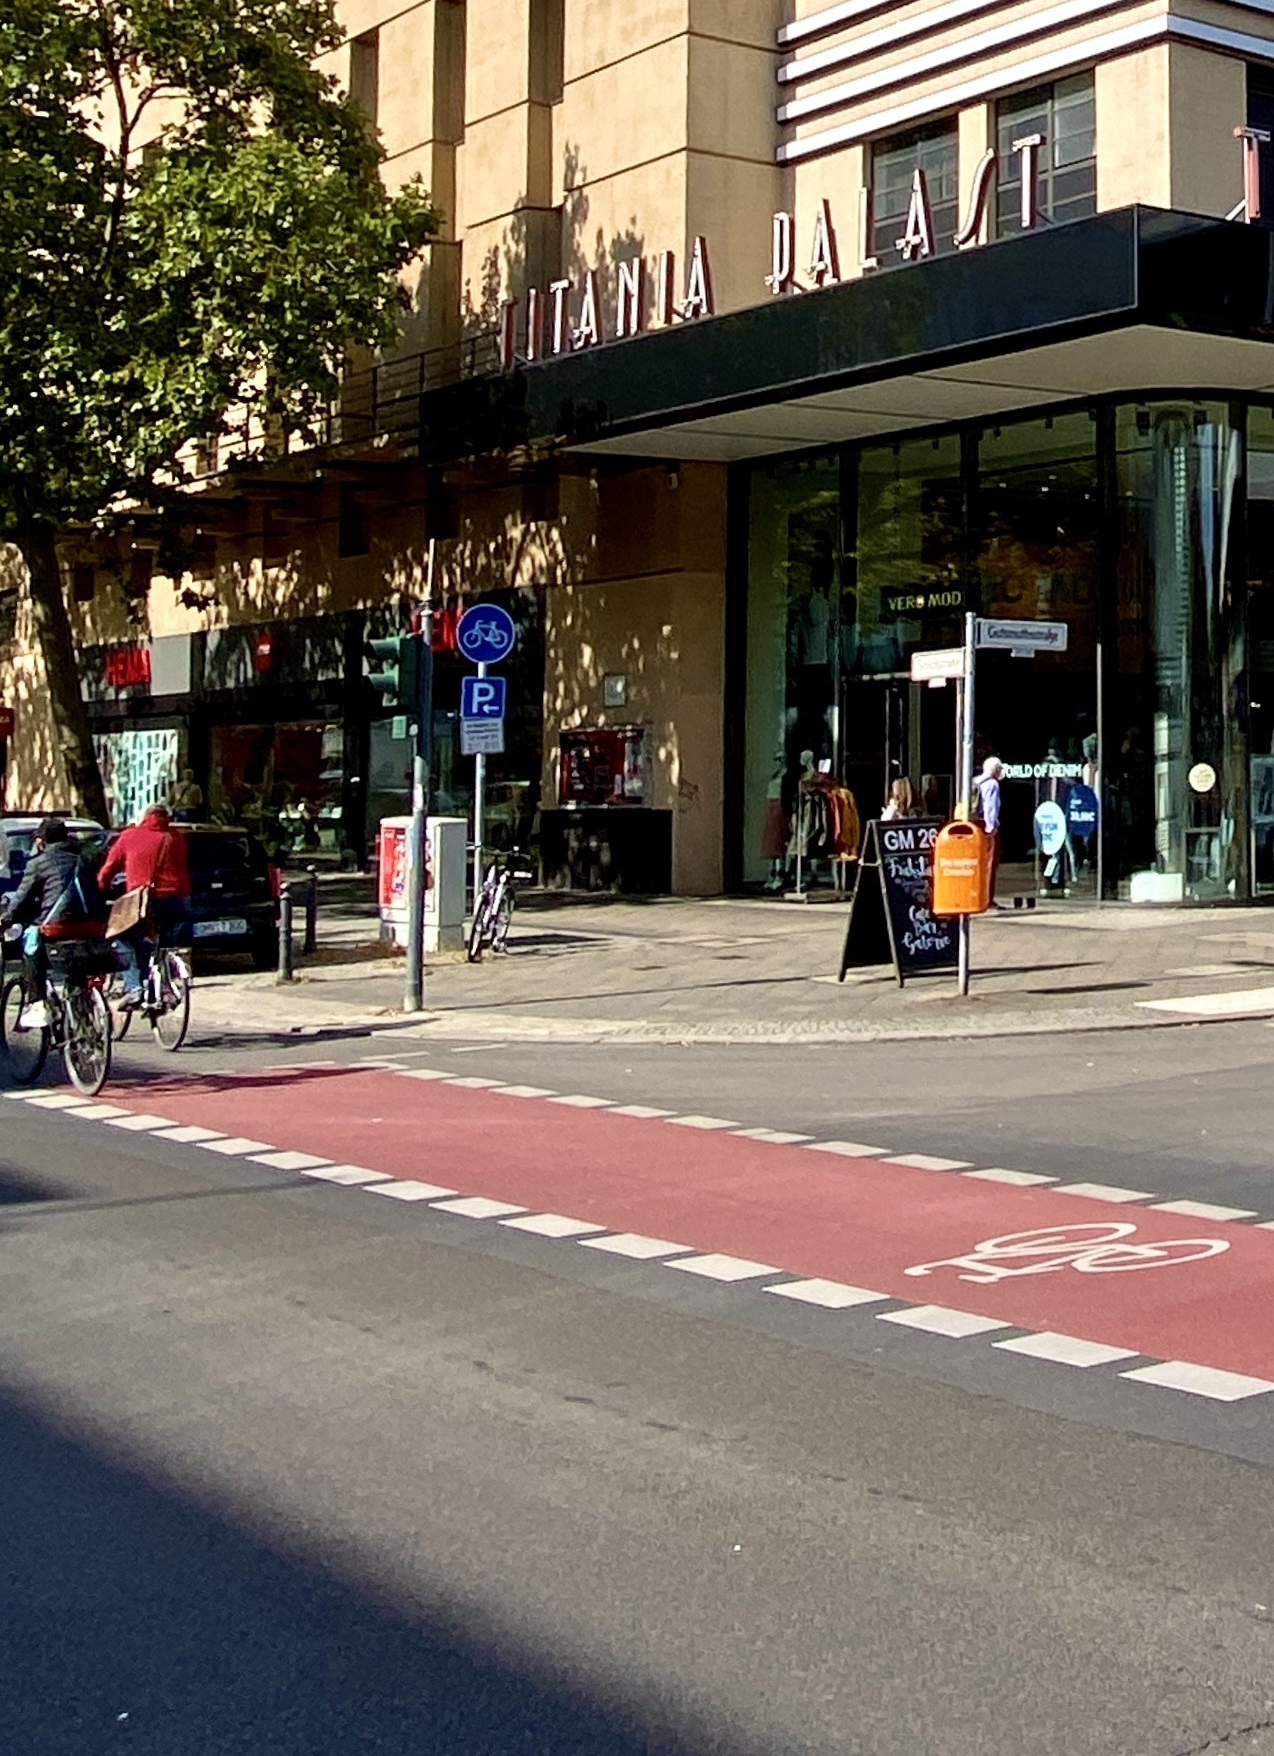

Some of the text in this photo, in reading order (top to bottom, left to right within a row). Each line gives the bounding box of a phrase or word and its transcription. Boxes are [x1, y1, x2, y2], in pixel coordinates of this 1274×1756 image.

[500, 133, 1046, 369] TITANIA PALAST
[887, 590, 963, 611] VERO MOD
[472, 682, 495, 714] P
[1034, 763, 1048, 778] OF
[884, 829, 915, 851] GM
